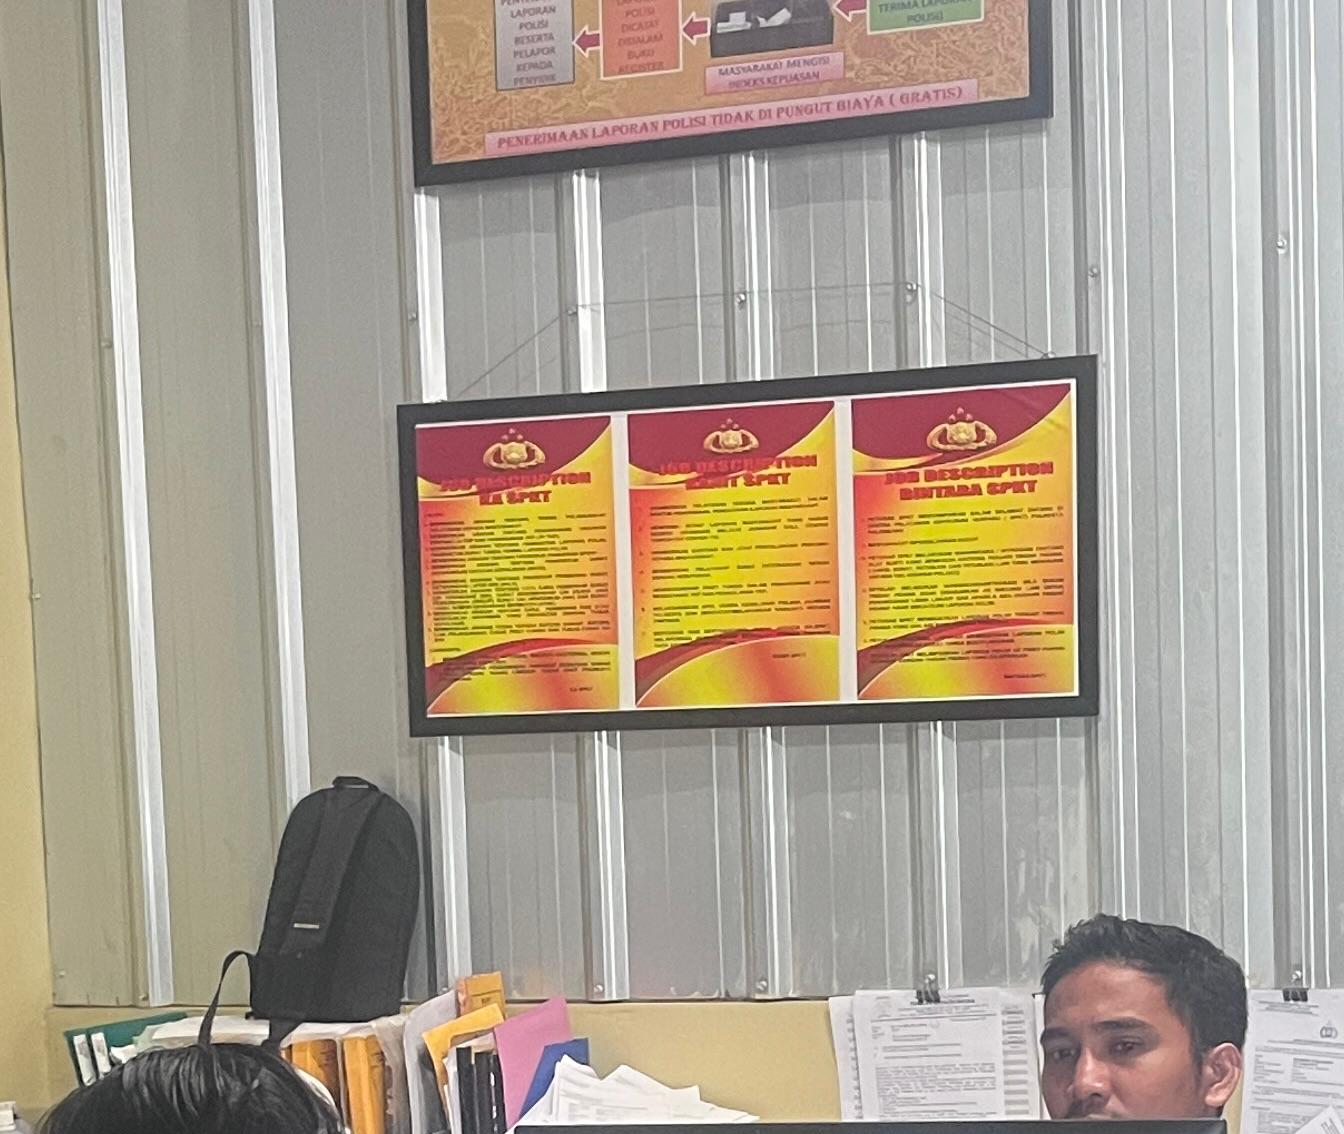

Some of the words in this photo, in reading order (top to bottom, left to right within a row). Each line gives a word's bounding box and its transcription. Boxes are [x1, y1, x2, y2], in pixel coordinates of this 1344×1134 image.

[510, 6, 556, 18] LAPORAN
[518, 20, 549, 30] POLISI
[513, 46, 556, 59] PELAPOR
[516, 62, 554, 73] KEPADA
[718, 61, 783, 76] MASYARAKAT
[766, 71, 821, 86] KEPUASAN
[497, 128, 590, 149] PENERIMAAN
[592, 121, 657, 139] LAPORAN
[662, 115, 706, 132] POLISI
[711, 110, 755, 126] TIDAK
[758, 108, 772, 120] DI
[776, 102, 832, 119] PUNGUT
[836, 94, 884, 112] BIAYA
[696, 454, 818, 474] DESCRIPTION
[743, 472, 792, 487] SPKT
[884, 472, 920, 485] JOB
[924, 461, 1054, 482] DESCRIPTION
[476, 472, 592, 491] DESCRIPTION
[986, 479, 1038, 495] SPKT
[506, 490, 552, 504] SPKT
